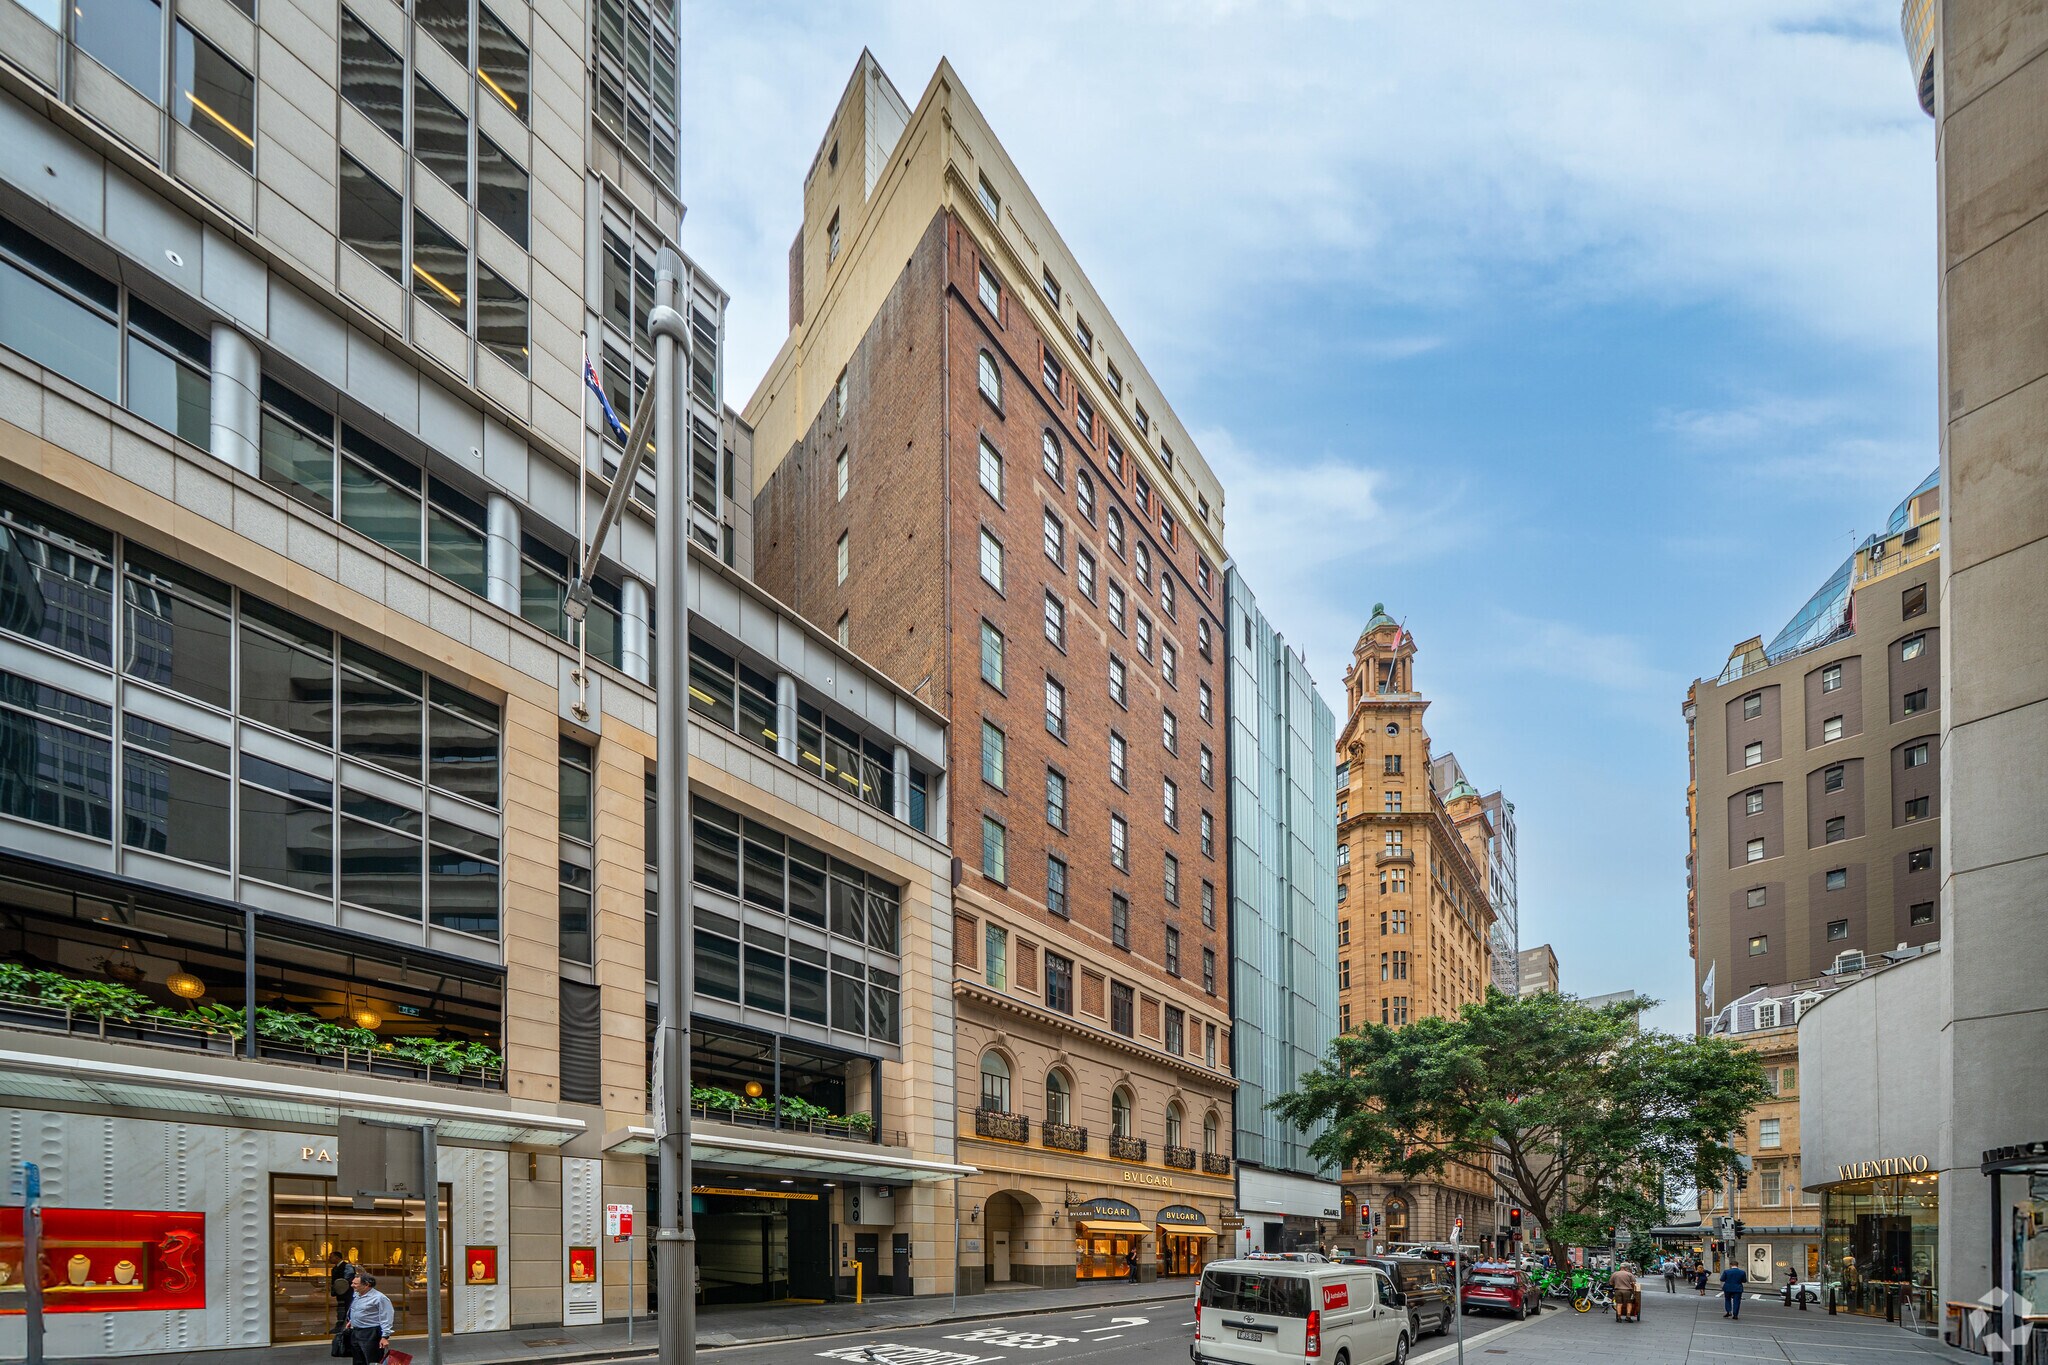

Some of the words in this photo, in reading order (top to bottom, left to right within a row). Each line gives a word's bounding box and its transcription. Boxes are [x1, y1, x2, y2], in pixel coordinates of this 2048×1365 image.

[301, 1147, 338, 1162] PA
[1838, 1154, 1928, 1181] VALENTINO
[1124, 1171, 1173, 1187] BVLGARI
[1093, 1206, 1130, 1216] VLGARI
[1166, 1211, 1198, 1221] BVLGARI
